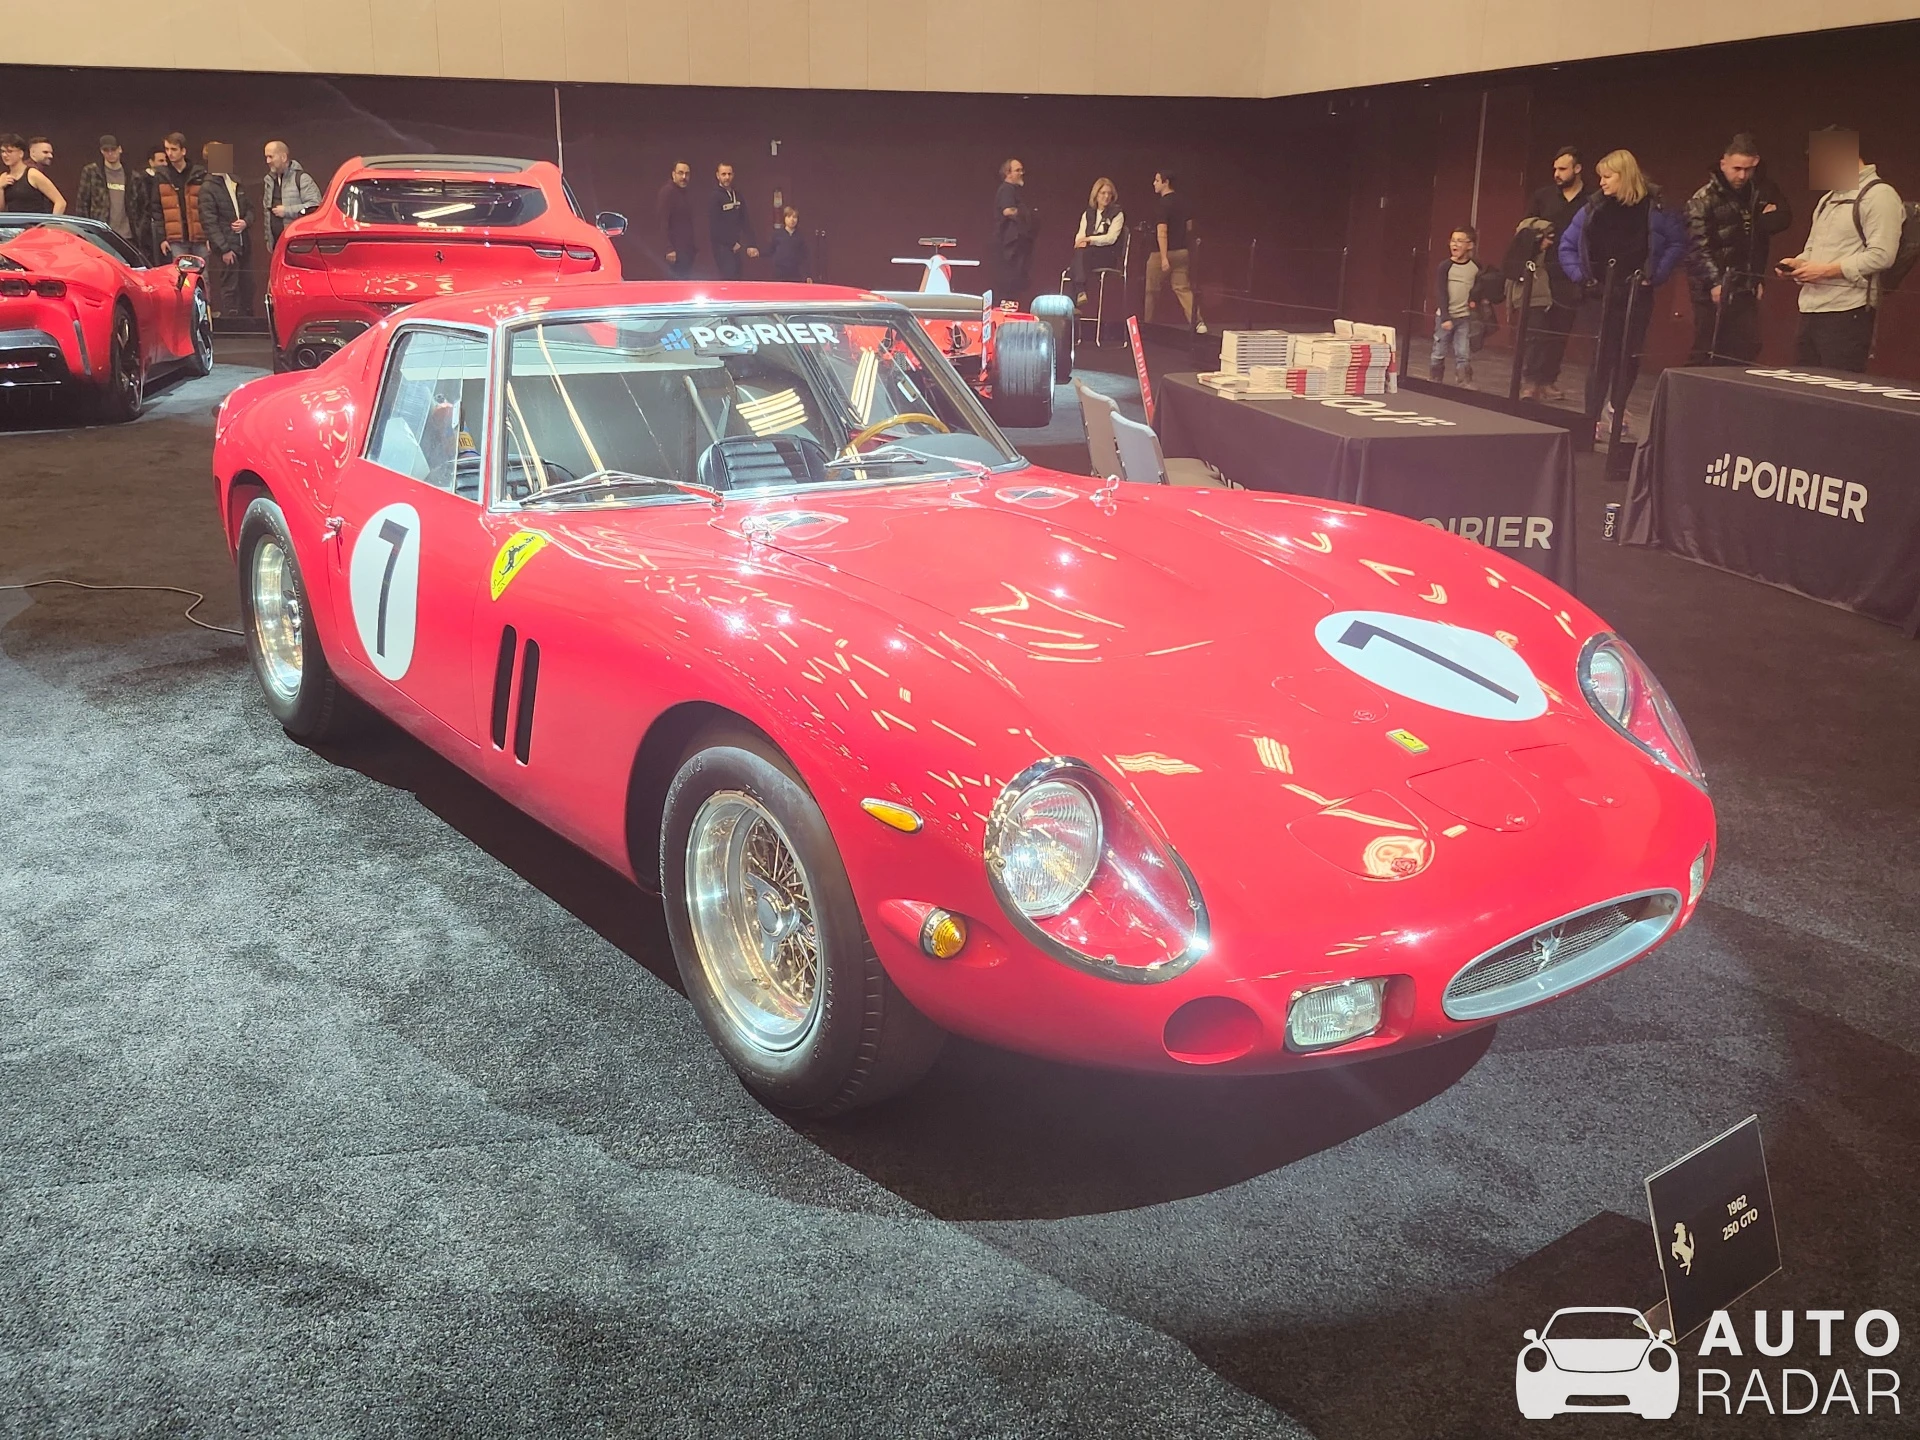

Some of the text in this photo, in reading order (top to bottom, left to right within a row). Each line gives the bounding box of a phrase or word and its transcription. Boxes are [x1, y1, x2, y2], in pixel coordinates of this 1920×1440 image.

[689, 323, 840, 348] POIRIER
[1732, 456, 1868, 523] POIRIER
[1420, 517, 1554, 549] IRIER
[1604, 512, 1615, 538] eska
[377, 519, 410, 658] 7
[1337, 620, 1519, 704] 7
[1727, 1195, 1748, 1216] 1962
[1722, 1208, 1758, 1240] 250 GTO
